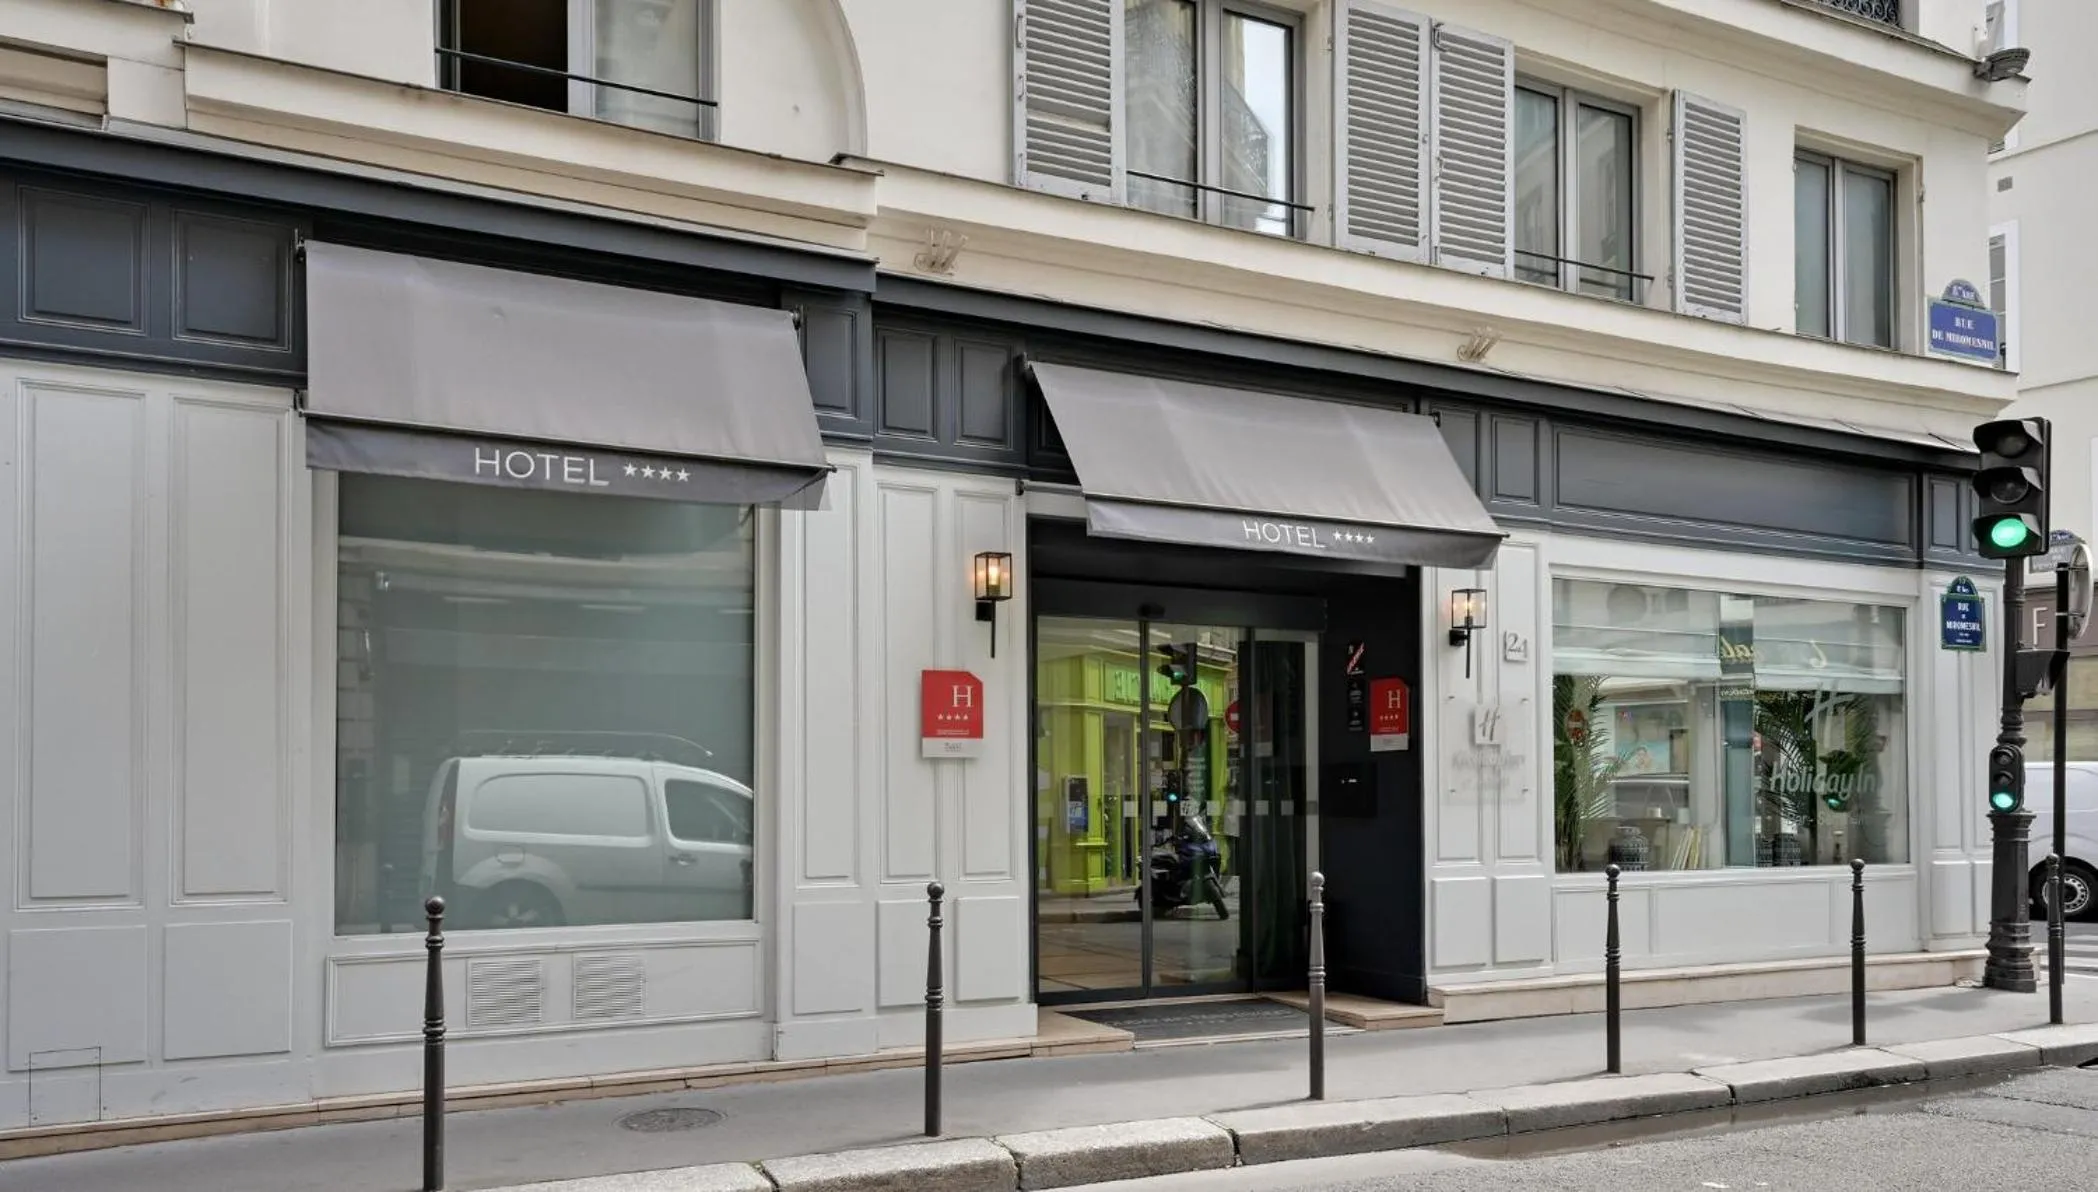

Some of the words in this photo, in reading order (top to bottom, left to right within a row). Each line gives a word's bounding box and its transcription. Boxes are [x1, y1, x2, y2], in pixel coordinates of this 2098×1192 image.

[1932, 329, 1944, 341] DE
[475, 447, 609, 487] HOTEL
[1242, 519, 1327, 549] HOTEL
[952, 684, 973, 708] H
[1388, 689, 1401, 709] H
[1769, 760, 1854, 800] Holiday
